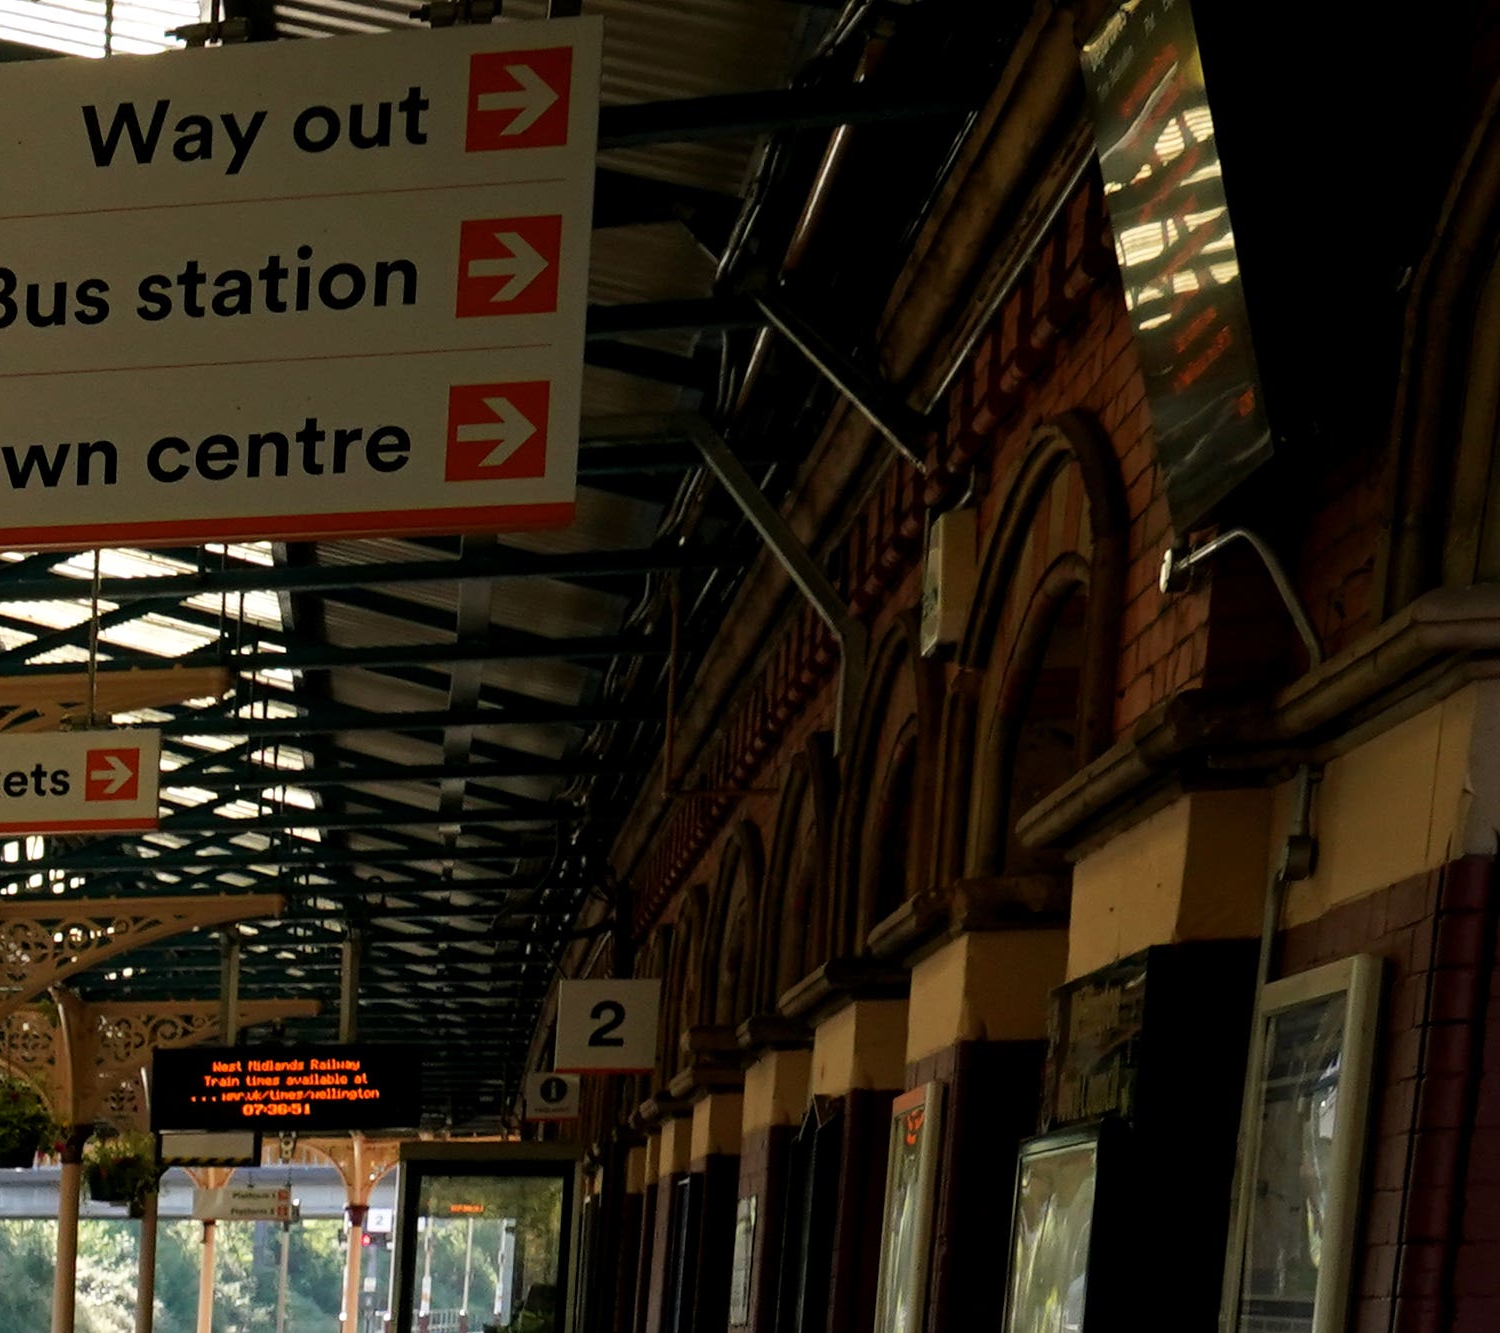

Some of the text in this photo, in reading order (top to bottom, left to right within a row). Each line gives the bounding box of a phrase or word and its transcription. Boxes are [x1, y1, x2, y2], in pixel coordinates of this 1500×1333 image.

[81, 85, 431, 176] Way out
[135, 244, 418, 322] station
[146, 416, 412, 484] centre
[587, 1000, 626, 1047] 2
[203, 1072, 368, 1087] Train times available at
[212, 1058, 360, 1072] West Midlands Railway
